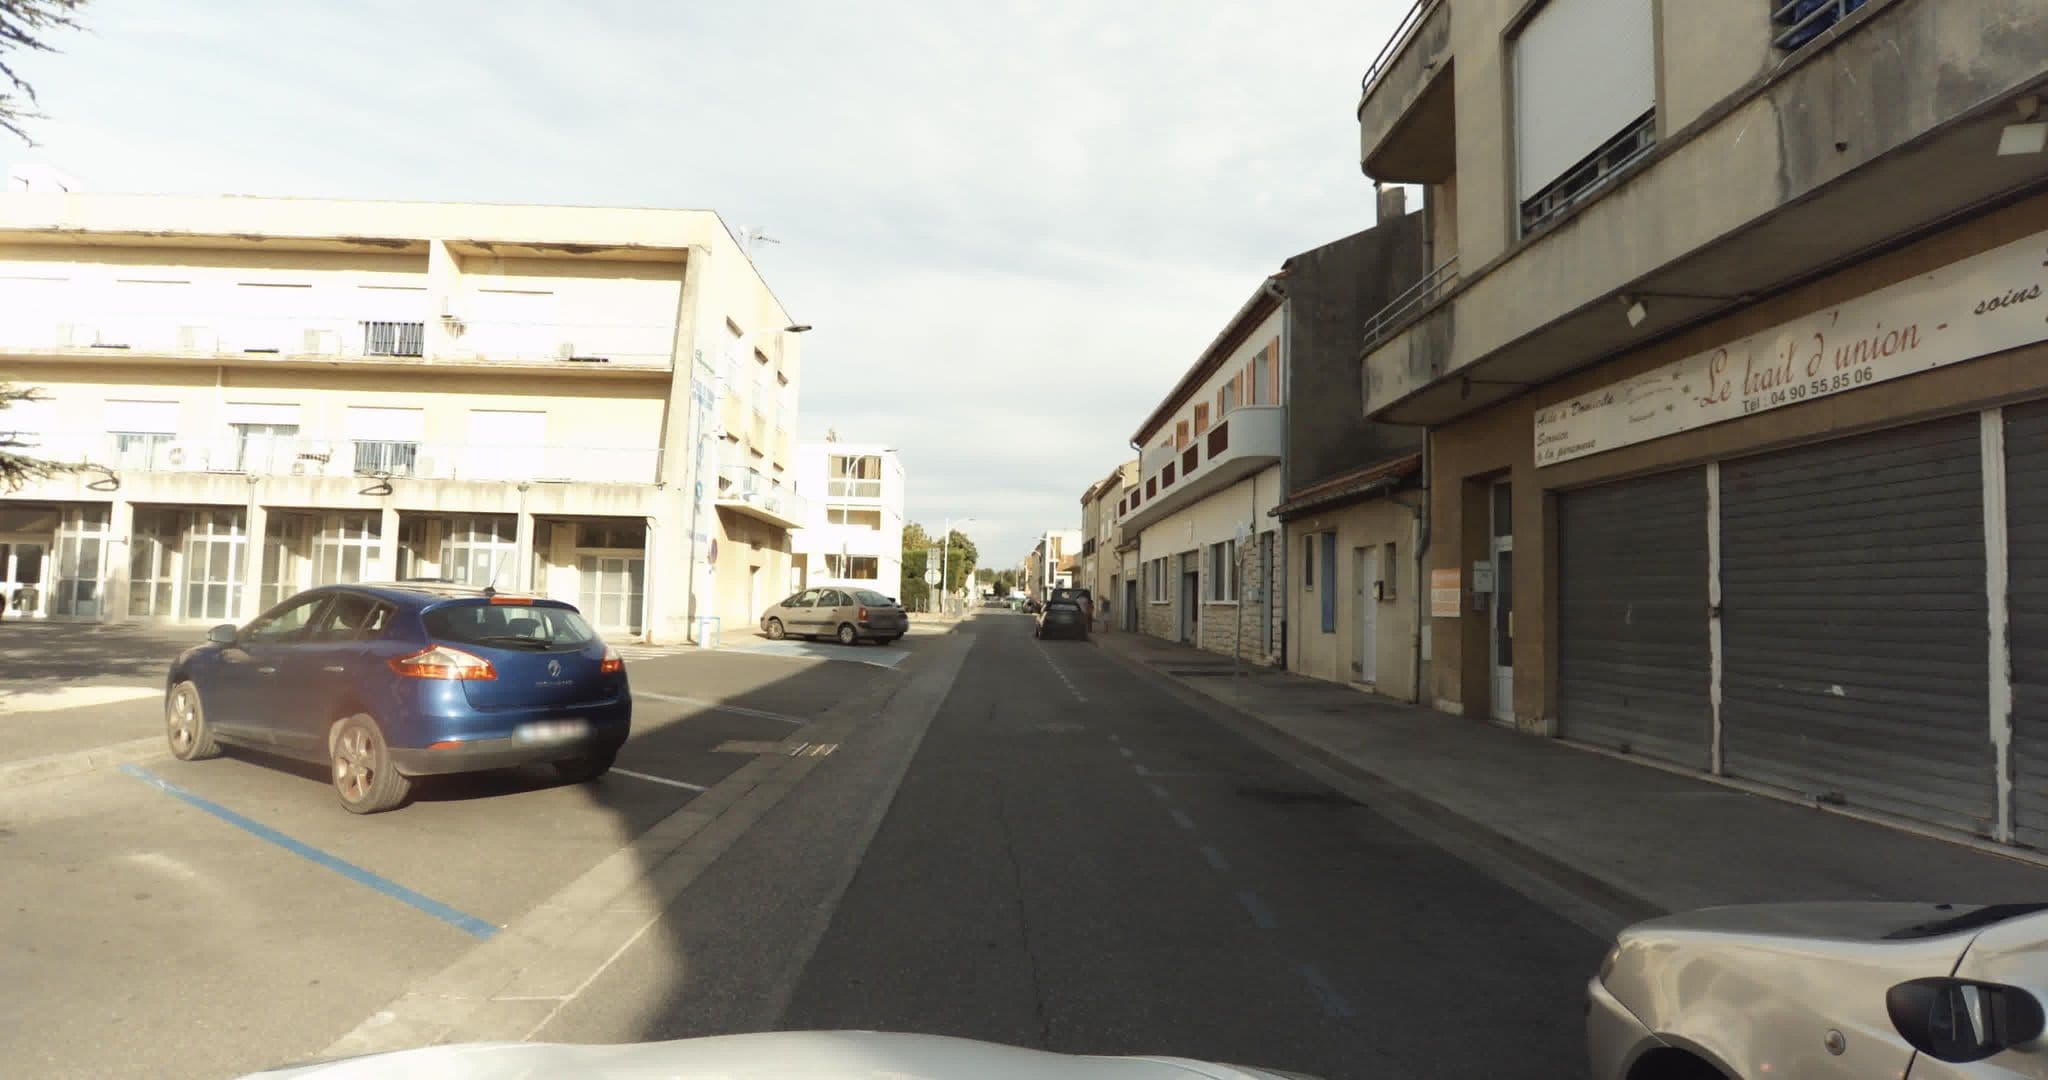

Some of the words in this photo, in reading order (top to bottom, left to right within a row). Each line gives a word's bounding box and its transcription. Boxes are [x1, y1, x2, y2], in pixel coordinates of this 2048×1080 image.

[1973, 284, 2042, 315] soins
[1770, 390, 1786, 406] 04
[1789, 384, 1806, 400] 90
[1854, 366, 1873, 384] 06
